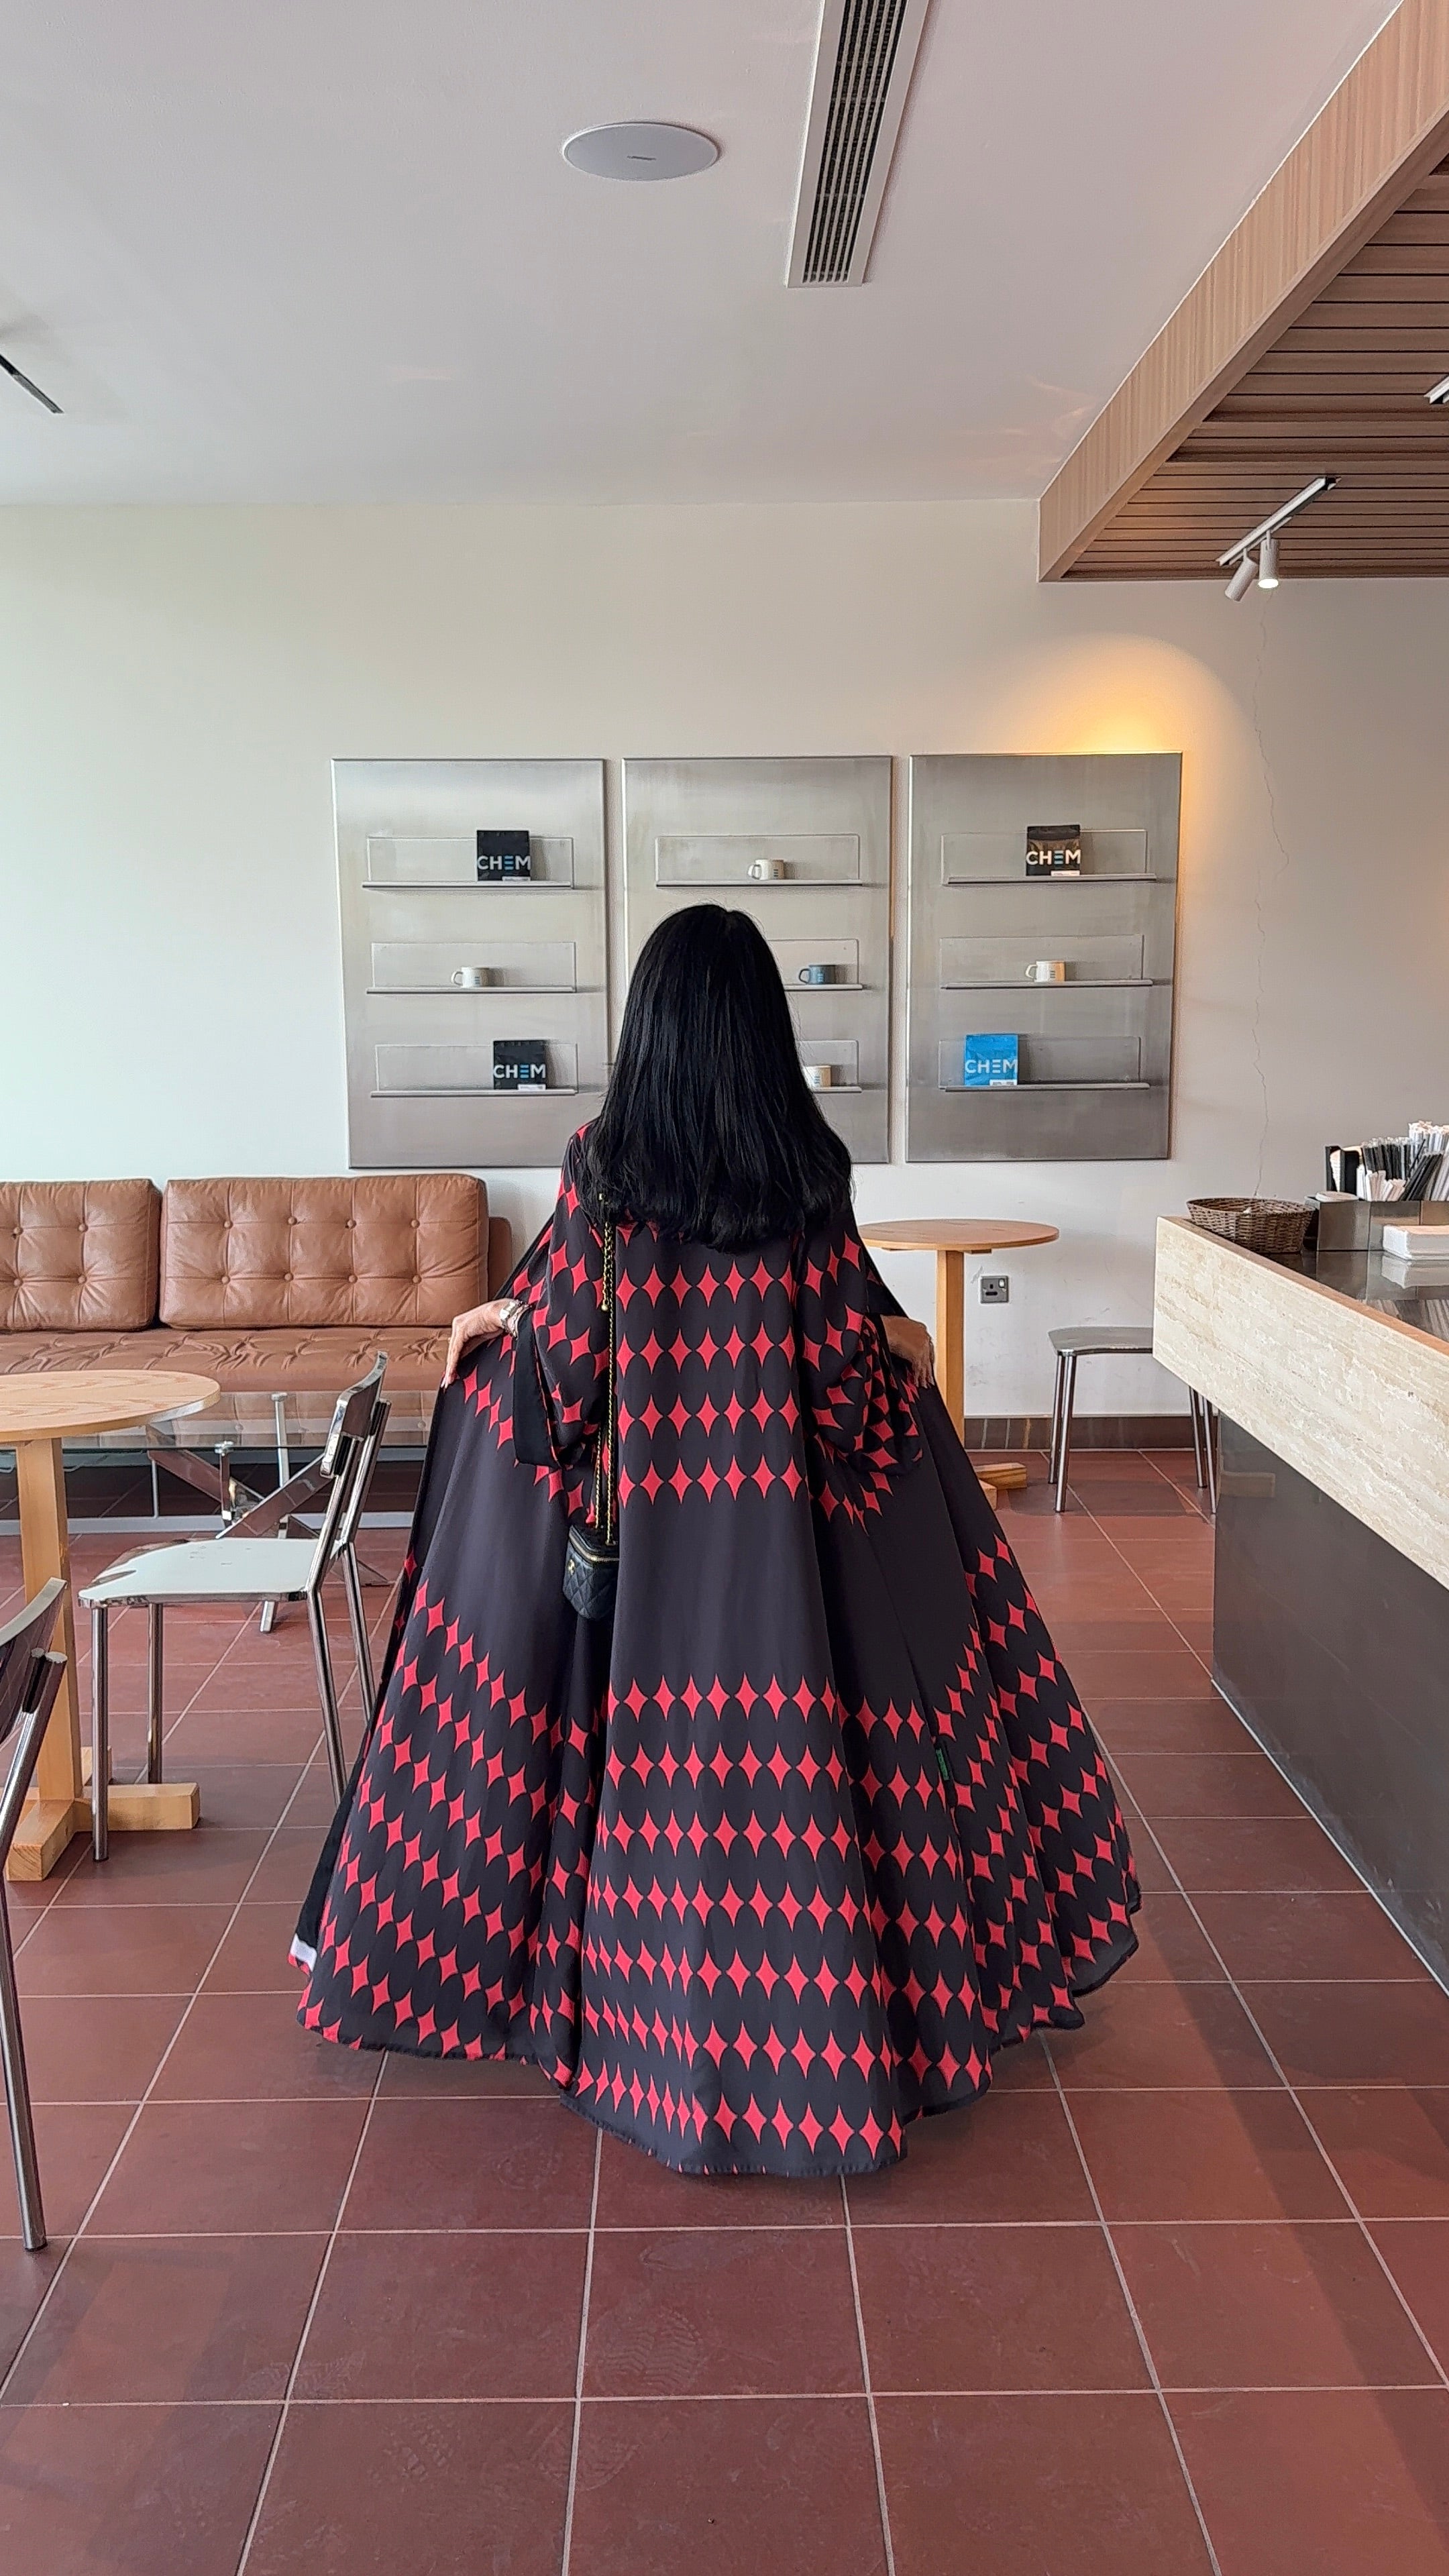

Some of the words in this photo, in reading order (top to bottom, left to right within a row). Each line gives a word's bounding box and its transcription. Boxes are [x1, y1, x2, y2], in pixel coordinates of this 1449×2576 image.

[477, 855, 531, 869] CHEM
[1026, 849, 1081, 865] CHEM
[494, 1064, 546, 1078] CHEM
[965, 1059, 1018, 1073] CHEM
